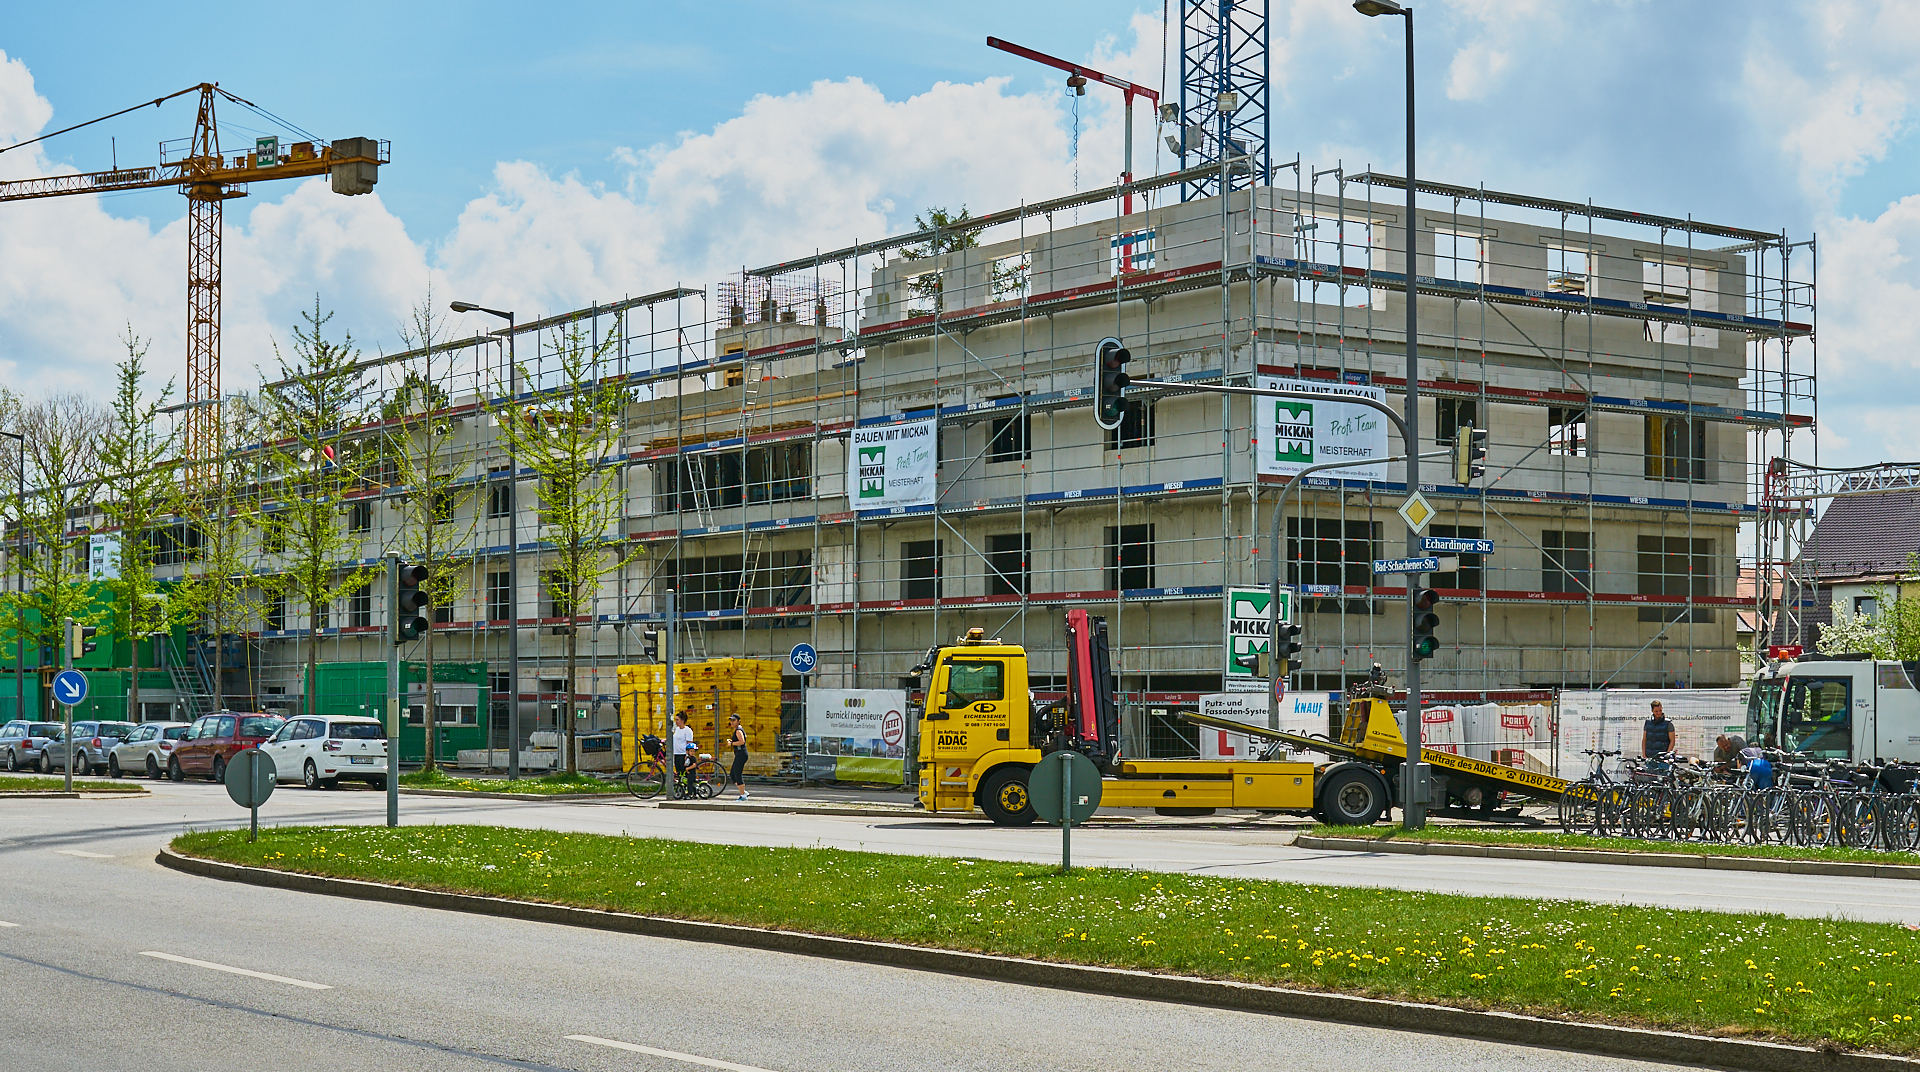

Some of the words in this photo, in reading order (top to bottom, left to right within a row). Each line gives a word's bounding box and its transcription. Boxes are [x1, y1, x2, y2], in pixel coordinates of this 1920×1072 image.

[1264, 256, 1286, 266] WIESER
[1307, 262, 1328, 271] WIESER
[1524, 289, 1545, 298] WIESER
[1629, 302, 1648, 311] WIESER
[1726, 314, 1744, 322] WIESER
[1163, 375, 1182, 384] WIESER
[1064, 389, 1082, 397] WIESER
[1270, 382, 1308, 393] BAUEN
[1312, 386, 1330, 394] MIT
[1334, 388, 1376, 400] MICKAN
[1629, 399, 1648, 407] WIESER
[1330, 418, 1352, 436] Profi
[1355, 413, 1377, 432] Team
[855, 431, 883, 443] BAUEN
[886, 430, 900, 440] MIT
[901, 425, 928, 439] MICKAN
[1275, 424, 1314, 438] MICKAN
[913, 446, 928, 463] Team
[1320, 446, 1372, 457] MEISTERHAFT
[860, 466, 884, 477] MICKAN
[889, 476, 924, 487] MEISTERHAFT
[1163, 481, 1183, 490] WIESER
[1308, 478, 1330, 486] WIESER
[1064, 489, 1082, 498] WIESER
[1527, 490, 1547, 498] WIESER
[1629, 497, 1648, 505] WIESER
[1425, 539, 1474, 552] Echardinger
[1476, 541, 1491, 551] Str.
[1375, 559, 1436, 572] Bad-Schachener-Str.
[1163, 587, 1183, 595] WIESER
[1308, 584, 1330, 593] WIESER
[1230, 620, 1270, 634] MICK
[826, 710, 850, 720] Burnickl
[850, 711, 883, 722] Ingenieure
[1425, 710, 1449, 720] PORIT
[885, 718, 899, 729] JETZT
[1504, 716, 1525, 725] PORIT
[938, 735, 967, 745] ADAC
[1423, 751, 1454, 767] Auftrag
[1458, 760, 1472, 770] des
[1474, 763, 1498, 775] ADAC
[1520, 773, 1542, 786] 0180
[1551, 781, 1563, 790] 22
